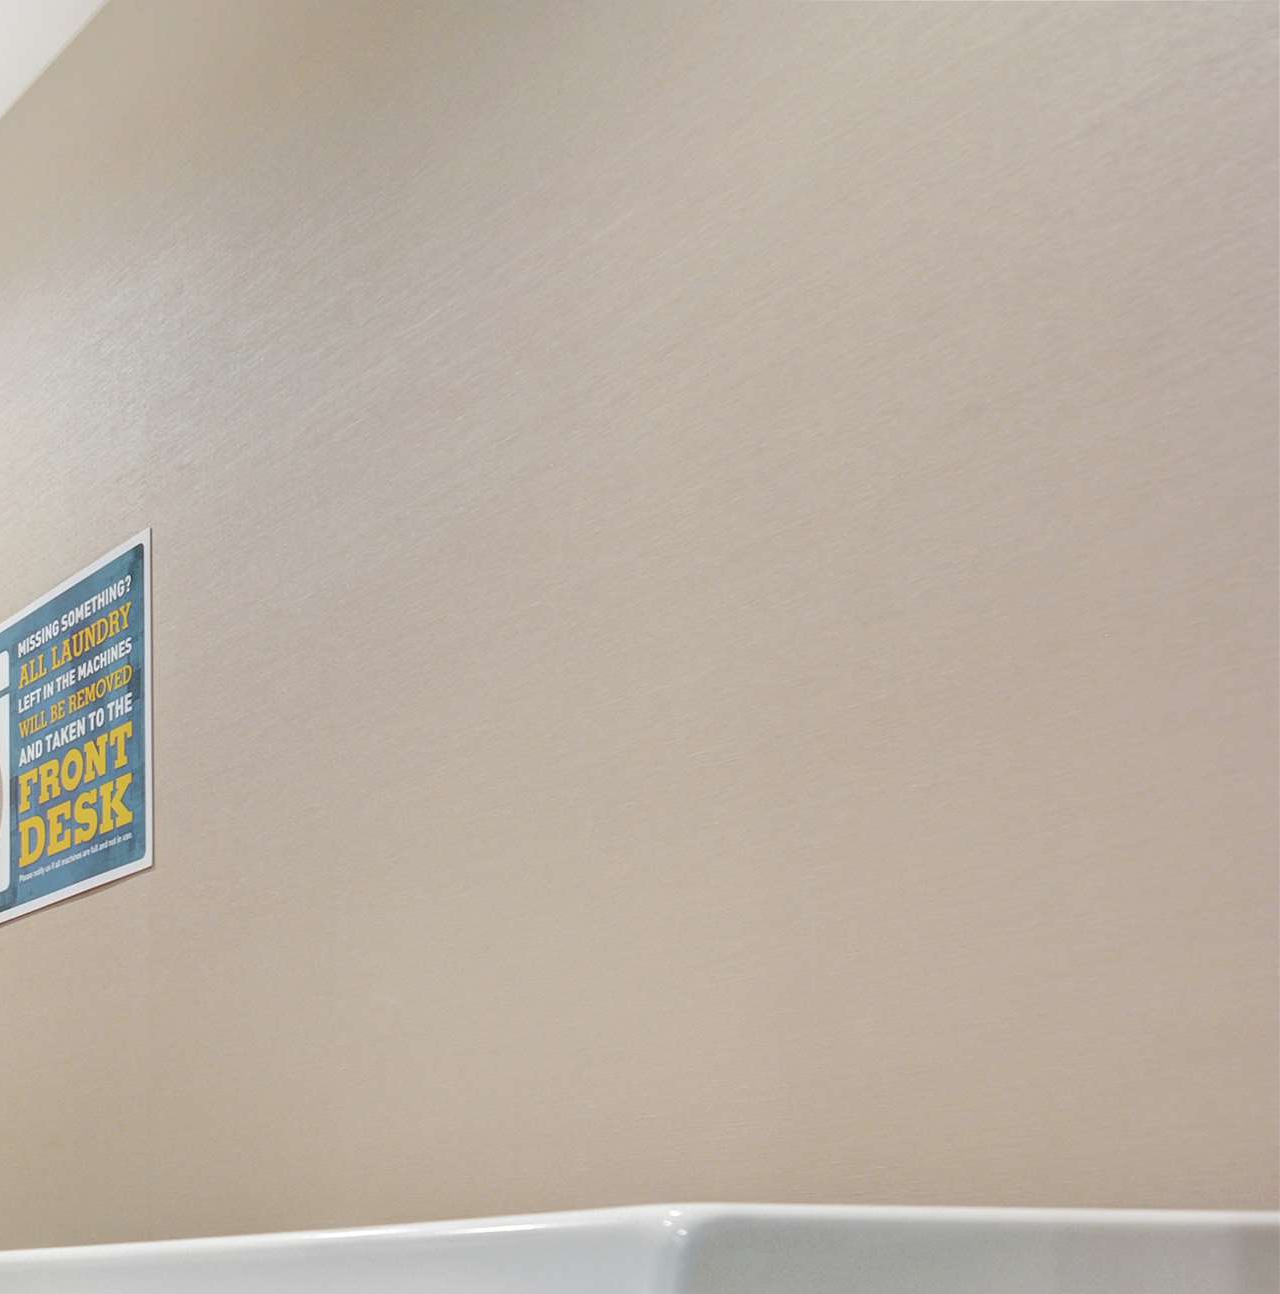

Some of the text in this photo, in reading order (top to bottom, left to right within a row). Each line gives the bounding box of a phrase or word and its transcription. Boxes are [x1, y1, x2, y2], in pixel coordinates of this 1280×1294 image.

[18, 575, 132, 658] MISSING SOMETHING?
[18, 601, 132, 689] ALL LAUNDRY
[18, 637, 132, 714] LEFT IN THE MACHINES
[18, 664, 133, 738] WILL BE REMOVED
[18, 720, 133, 814] FRONT
[19, 692, 133, 767] AND TAKEN TO THE
[18, 772, 133, 868] DESK
